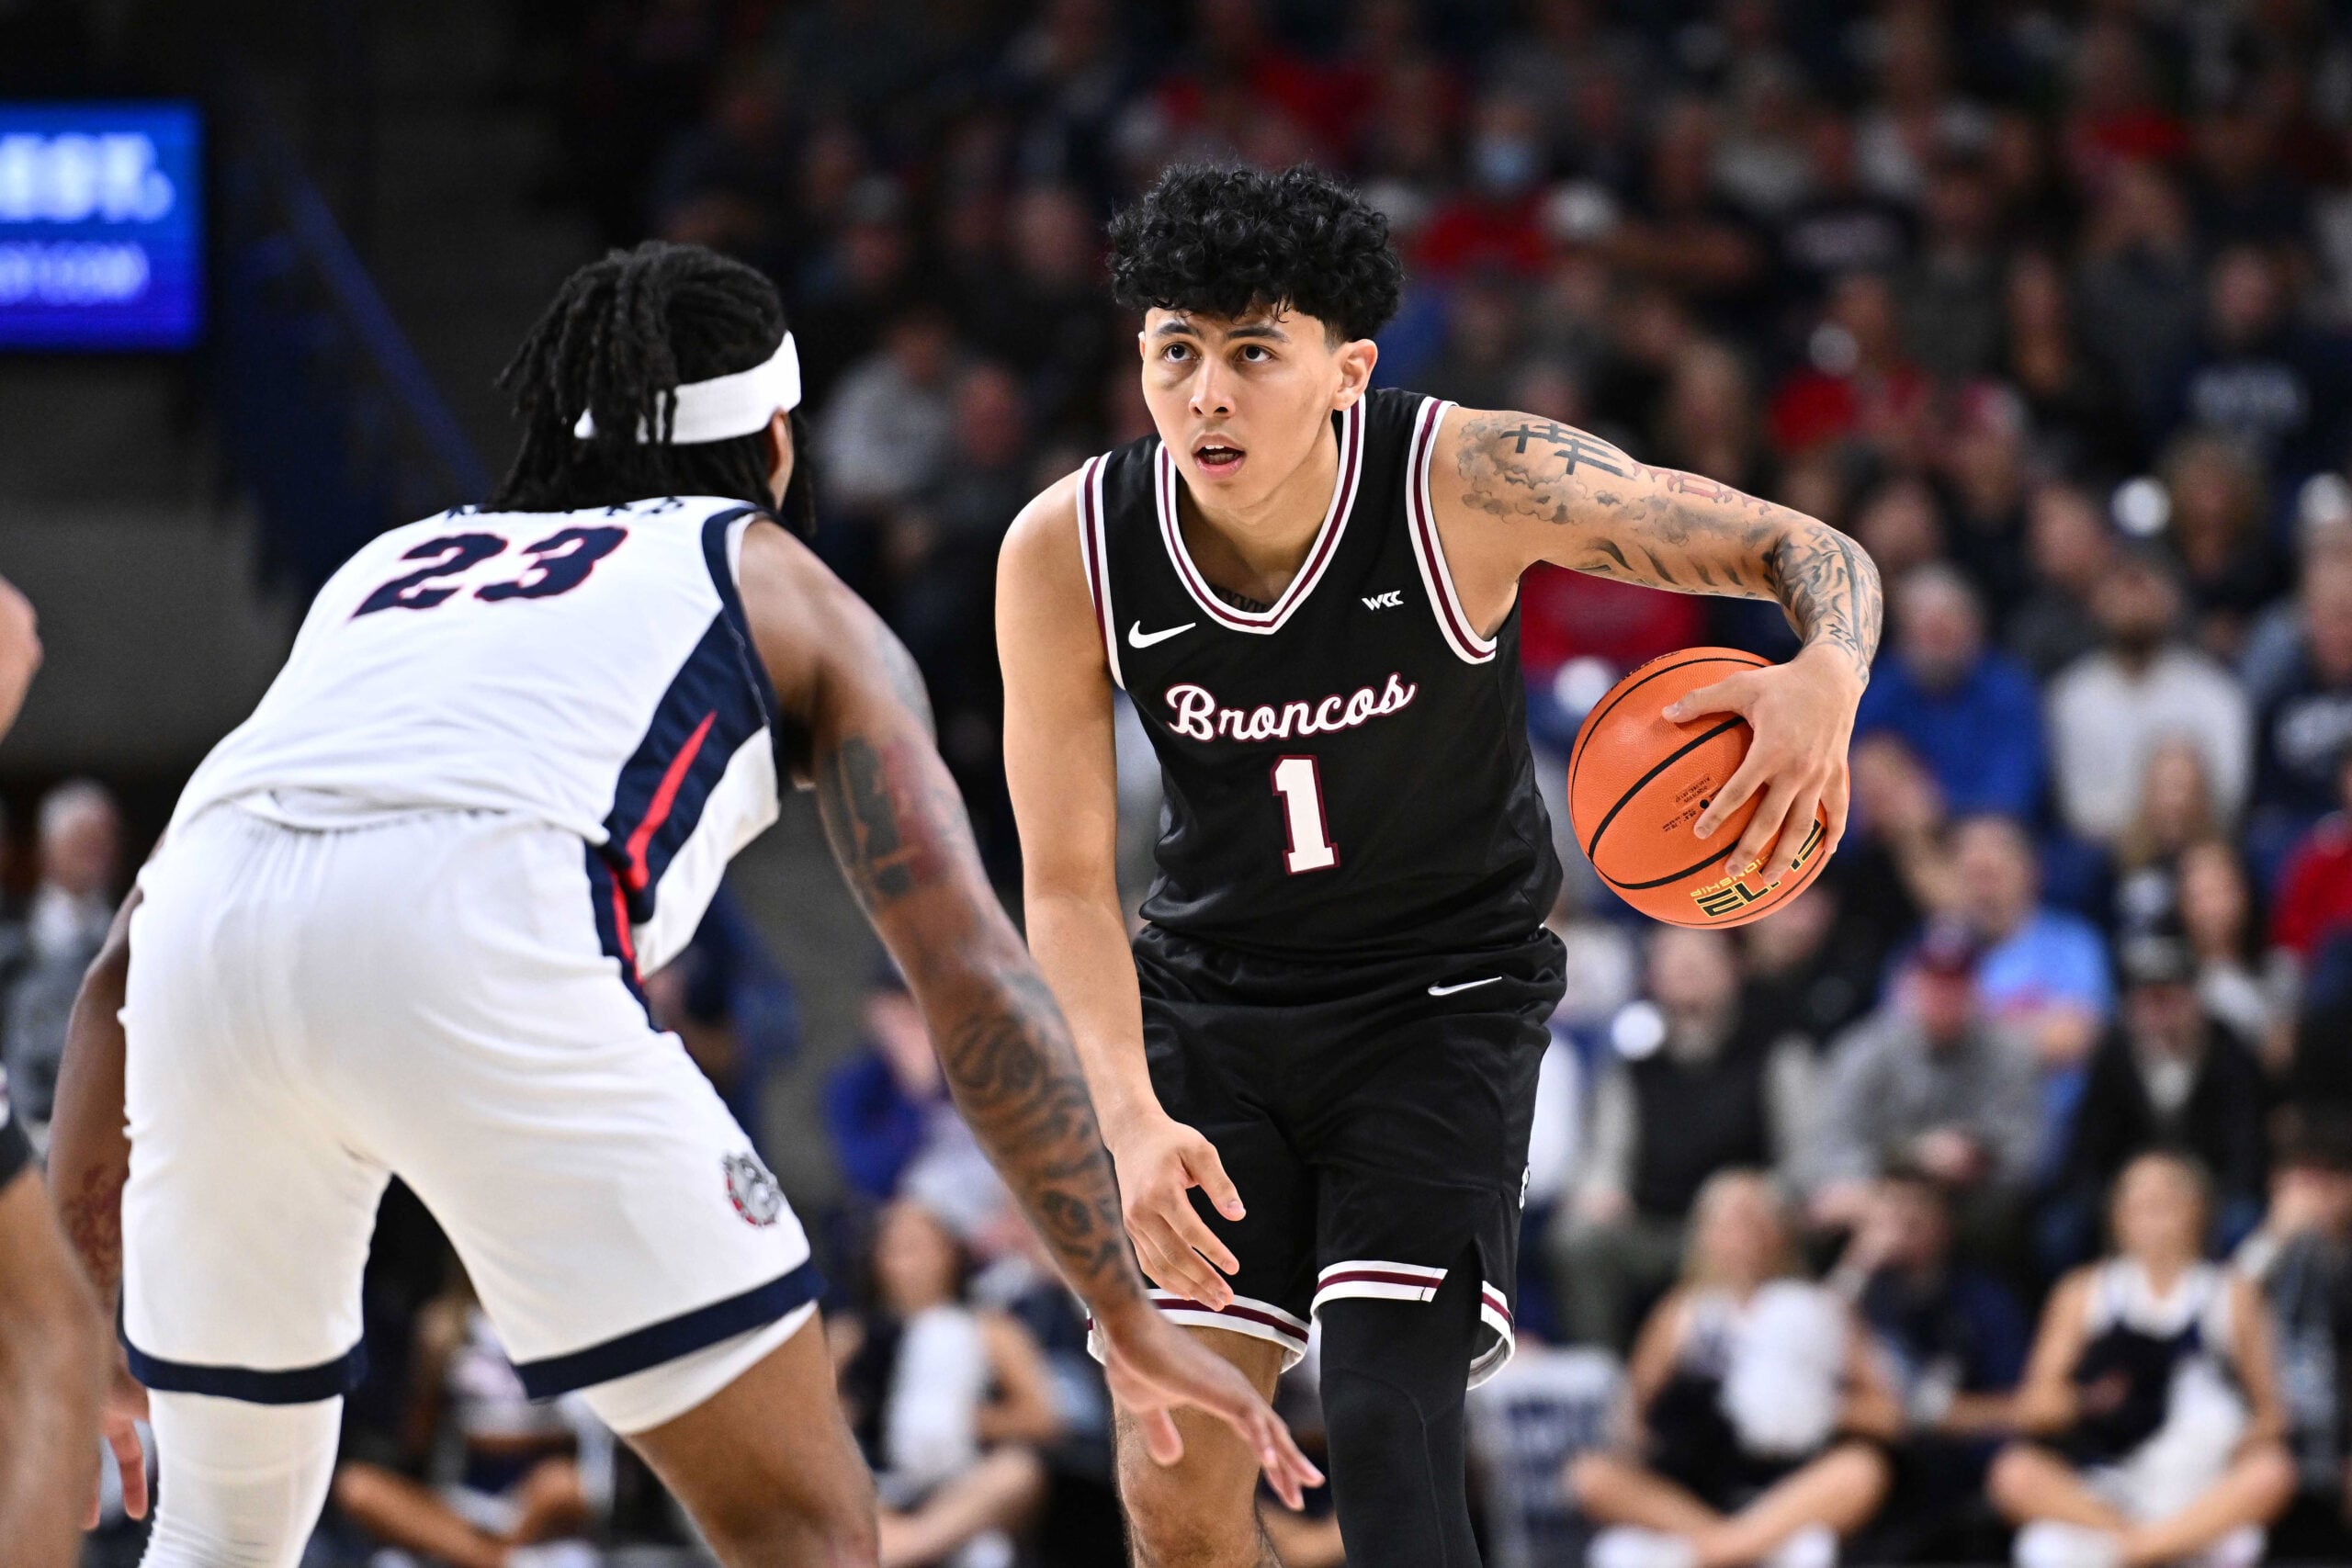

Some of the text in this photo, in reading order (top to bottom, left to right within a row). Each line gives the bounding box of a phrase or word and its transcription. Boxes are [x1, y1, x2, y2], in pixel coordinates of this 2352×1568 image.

[350, 525, 628, 623] 23
[1361, 590, 1405, 611] WCC
[1164, 671, 1418, 742] Broncos
[1270, 754, 1340, 875] 1
